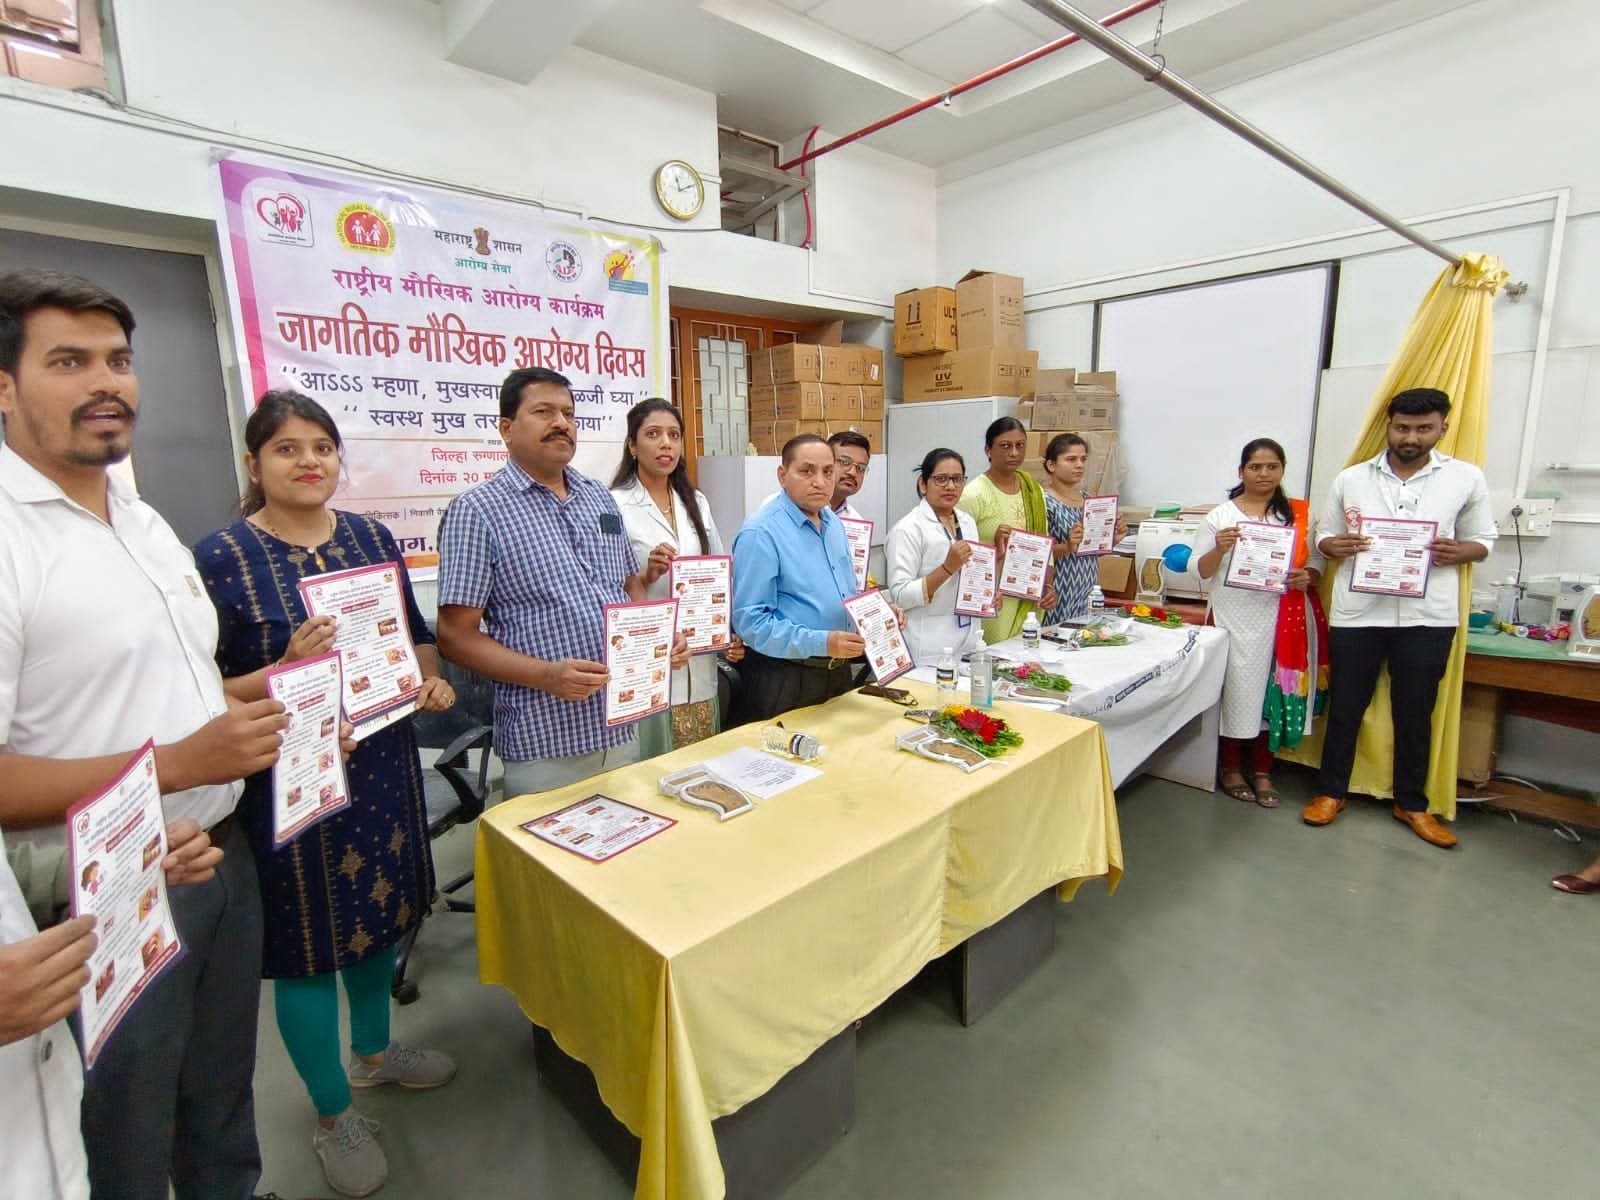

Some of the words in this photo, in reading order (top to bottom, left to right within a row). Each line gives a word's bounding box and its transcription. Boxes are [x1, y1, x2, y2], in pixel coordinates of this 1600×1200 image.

[433, 230, 473, 250] महाराष्ट्र
[492, 240, 523, 254] शासन
[455, 256, 488, 271] आरोग्य
[491, 259, 512, 274] सेवा
[332, 266, 392, 297] राष्ट्रीय
[400, 272, 473, 303] मौखिक
[482, 284, 541, 312] आरोग्य
[547, 294, 605, 320] कार्यक्रम
[276, 302, 400, 357] जागतिक
[406, 312, 507, 368] मौखिक
[514, 326, 590, 374] आरोग्य
[595, 331, 646, 380] दिवस
[936, 371, 952, 382] UV
[369, 409, 423, 428] स्वस्थ
[432, 411, 465, 434] मुख
[431, 447, 467, 463] जिल्हा
[419, 468, 457, 484] दिनांक
[463, 472, 479, 483] २०
